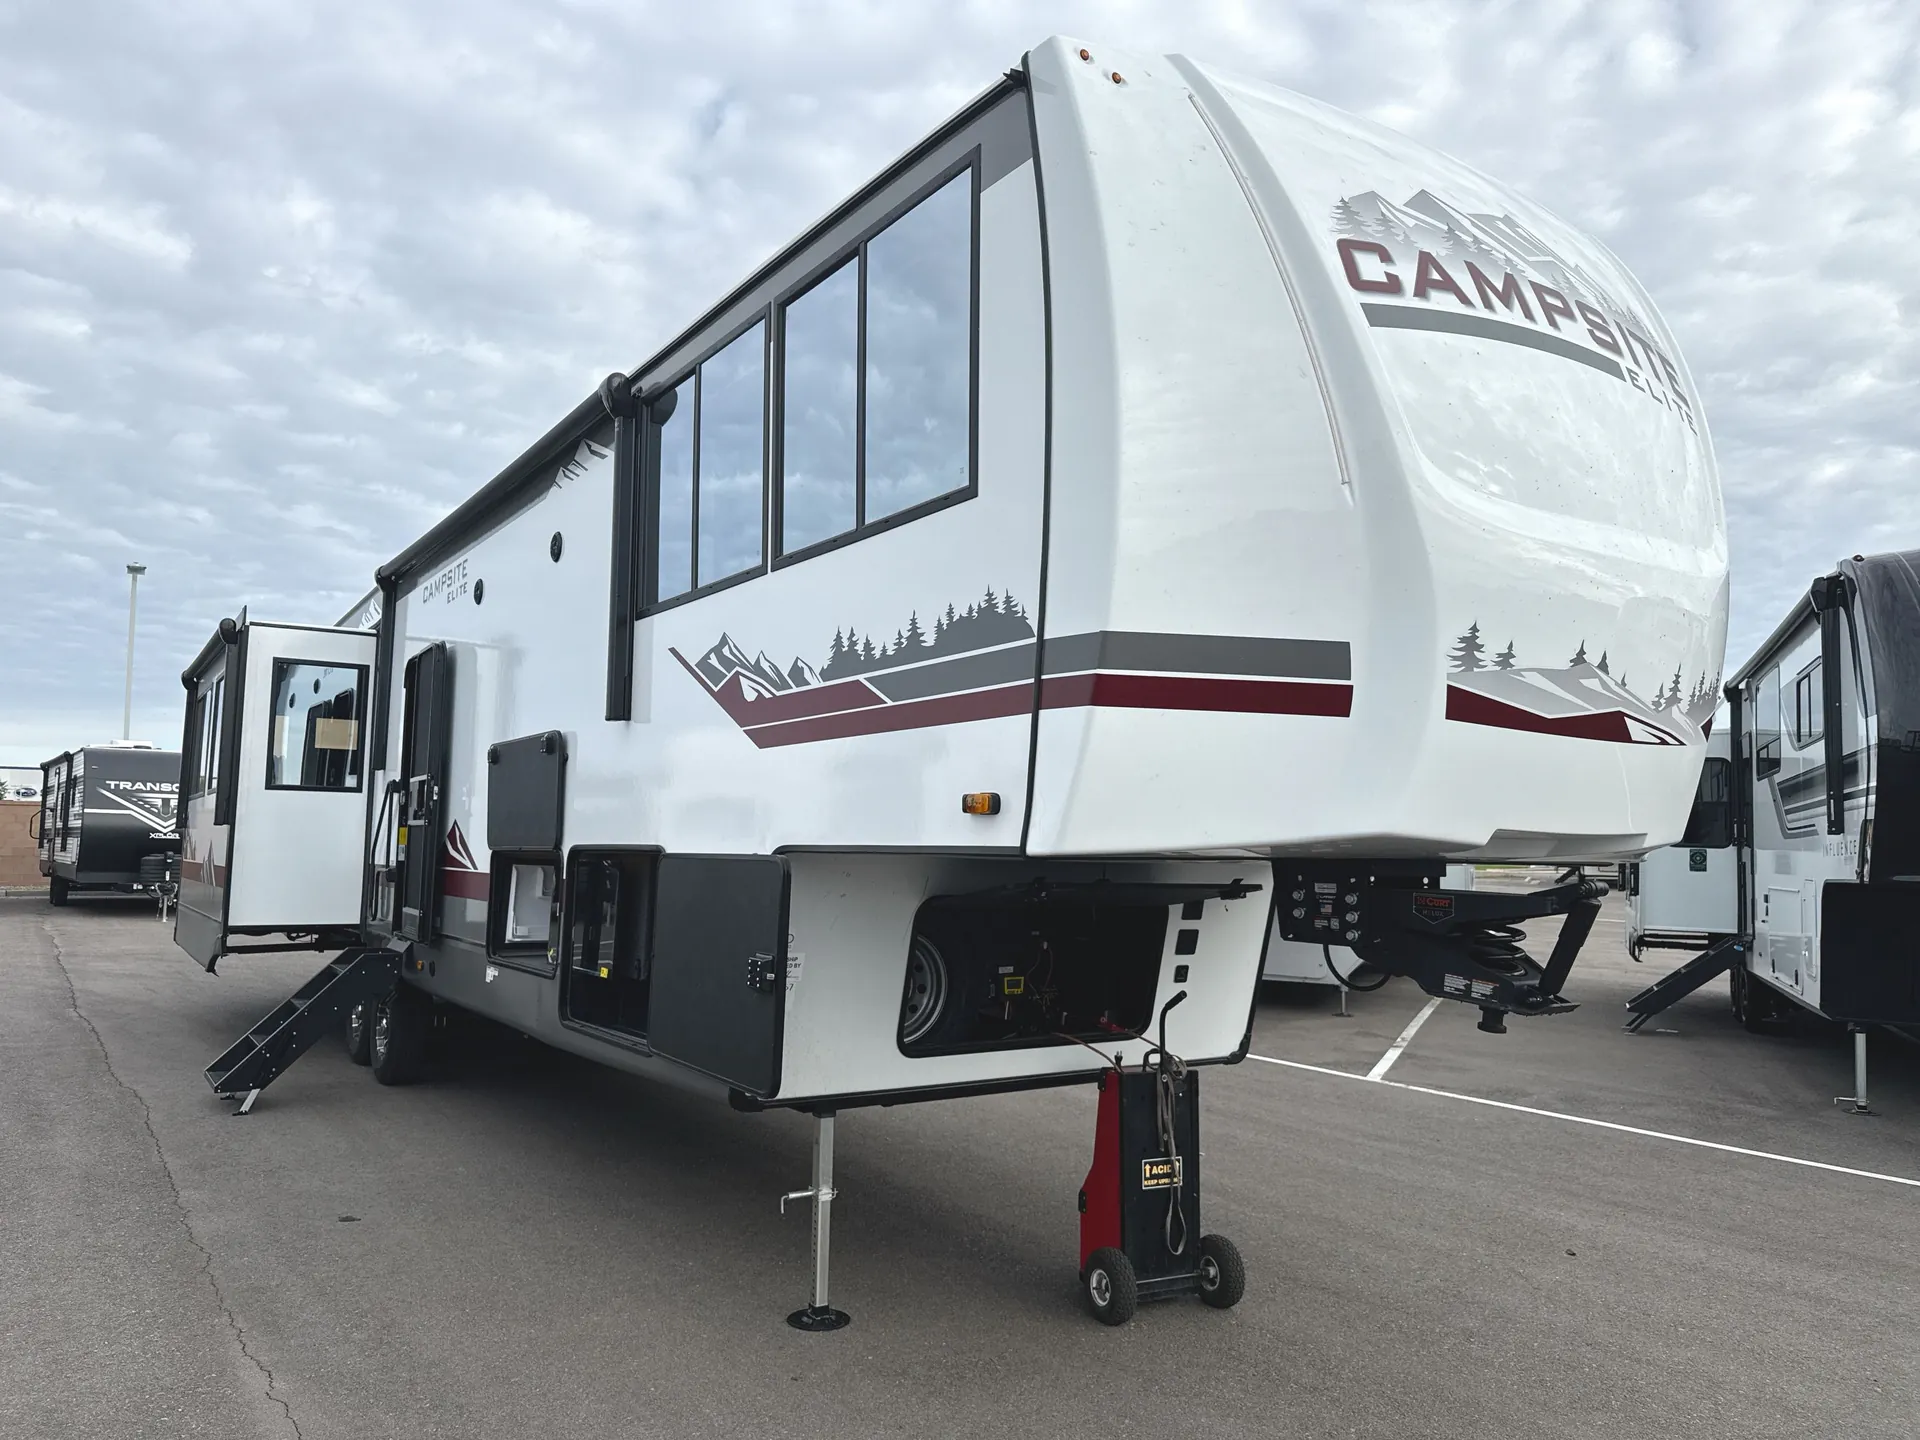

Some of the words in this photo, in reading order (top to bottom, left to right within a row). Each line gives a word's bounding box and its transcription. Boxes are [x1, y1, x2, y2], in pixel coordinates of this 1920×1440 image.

[1336, 237, 1692, 413] CAMPSITE
[1625, 365, 1698, 437] ELITE
[422, 558, 468, 604] CAMPSITE
[446, 581, 468, 604] ELITE
[1822, 839, 1857, 858] INFLUENCE
[1151, 1164, 1172, 1175] ACID
